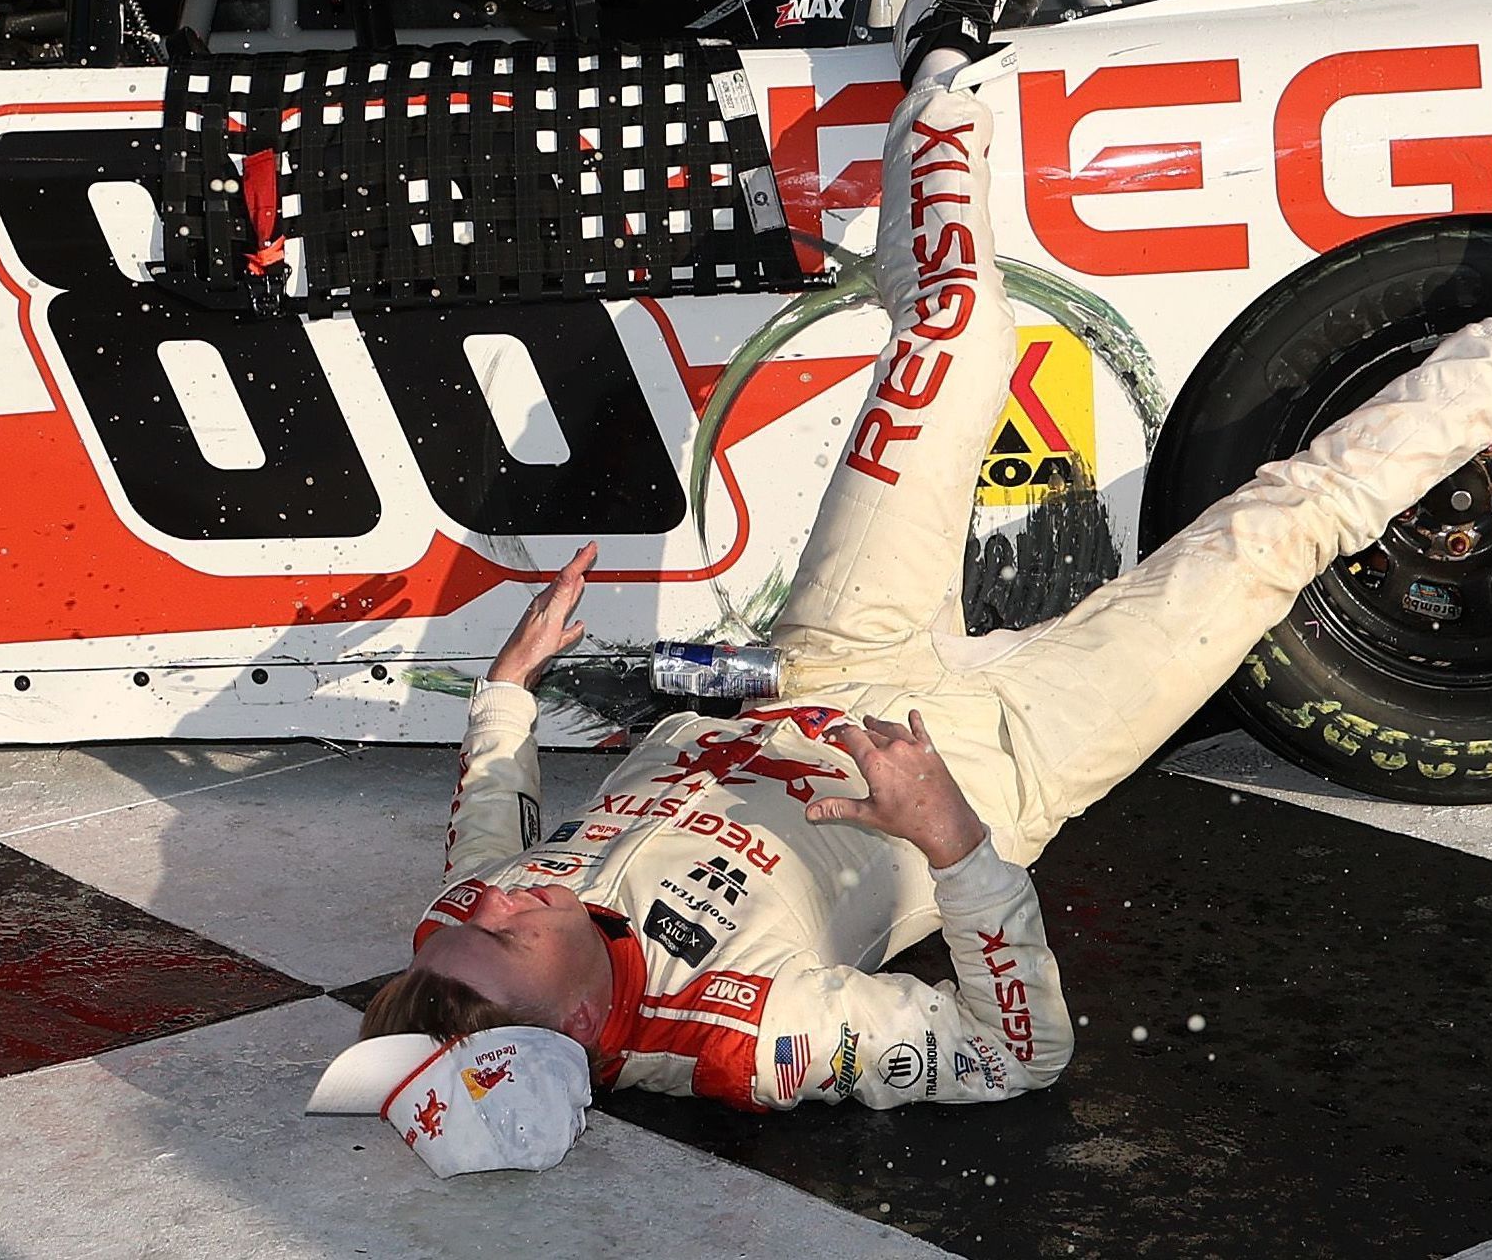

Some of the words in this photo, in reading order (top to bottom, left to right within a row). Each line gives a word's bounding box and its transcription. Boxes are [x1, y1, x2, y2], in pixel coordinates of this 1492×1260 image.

[845, 118, 977, 485] REGISTIX
[590, 795, 782, 876] REGISTIX
[706, 978, 757, 1005] OMP
